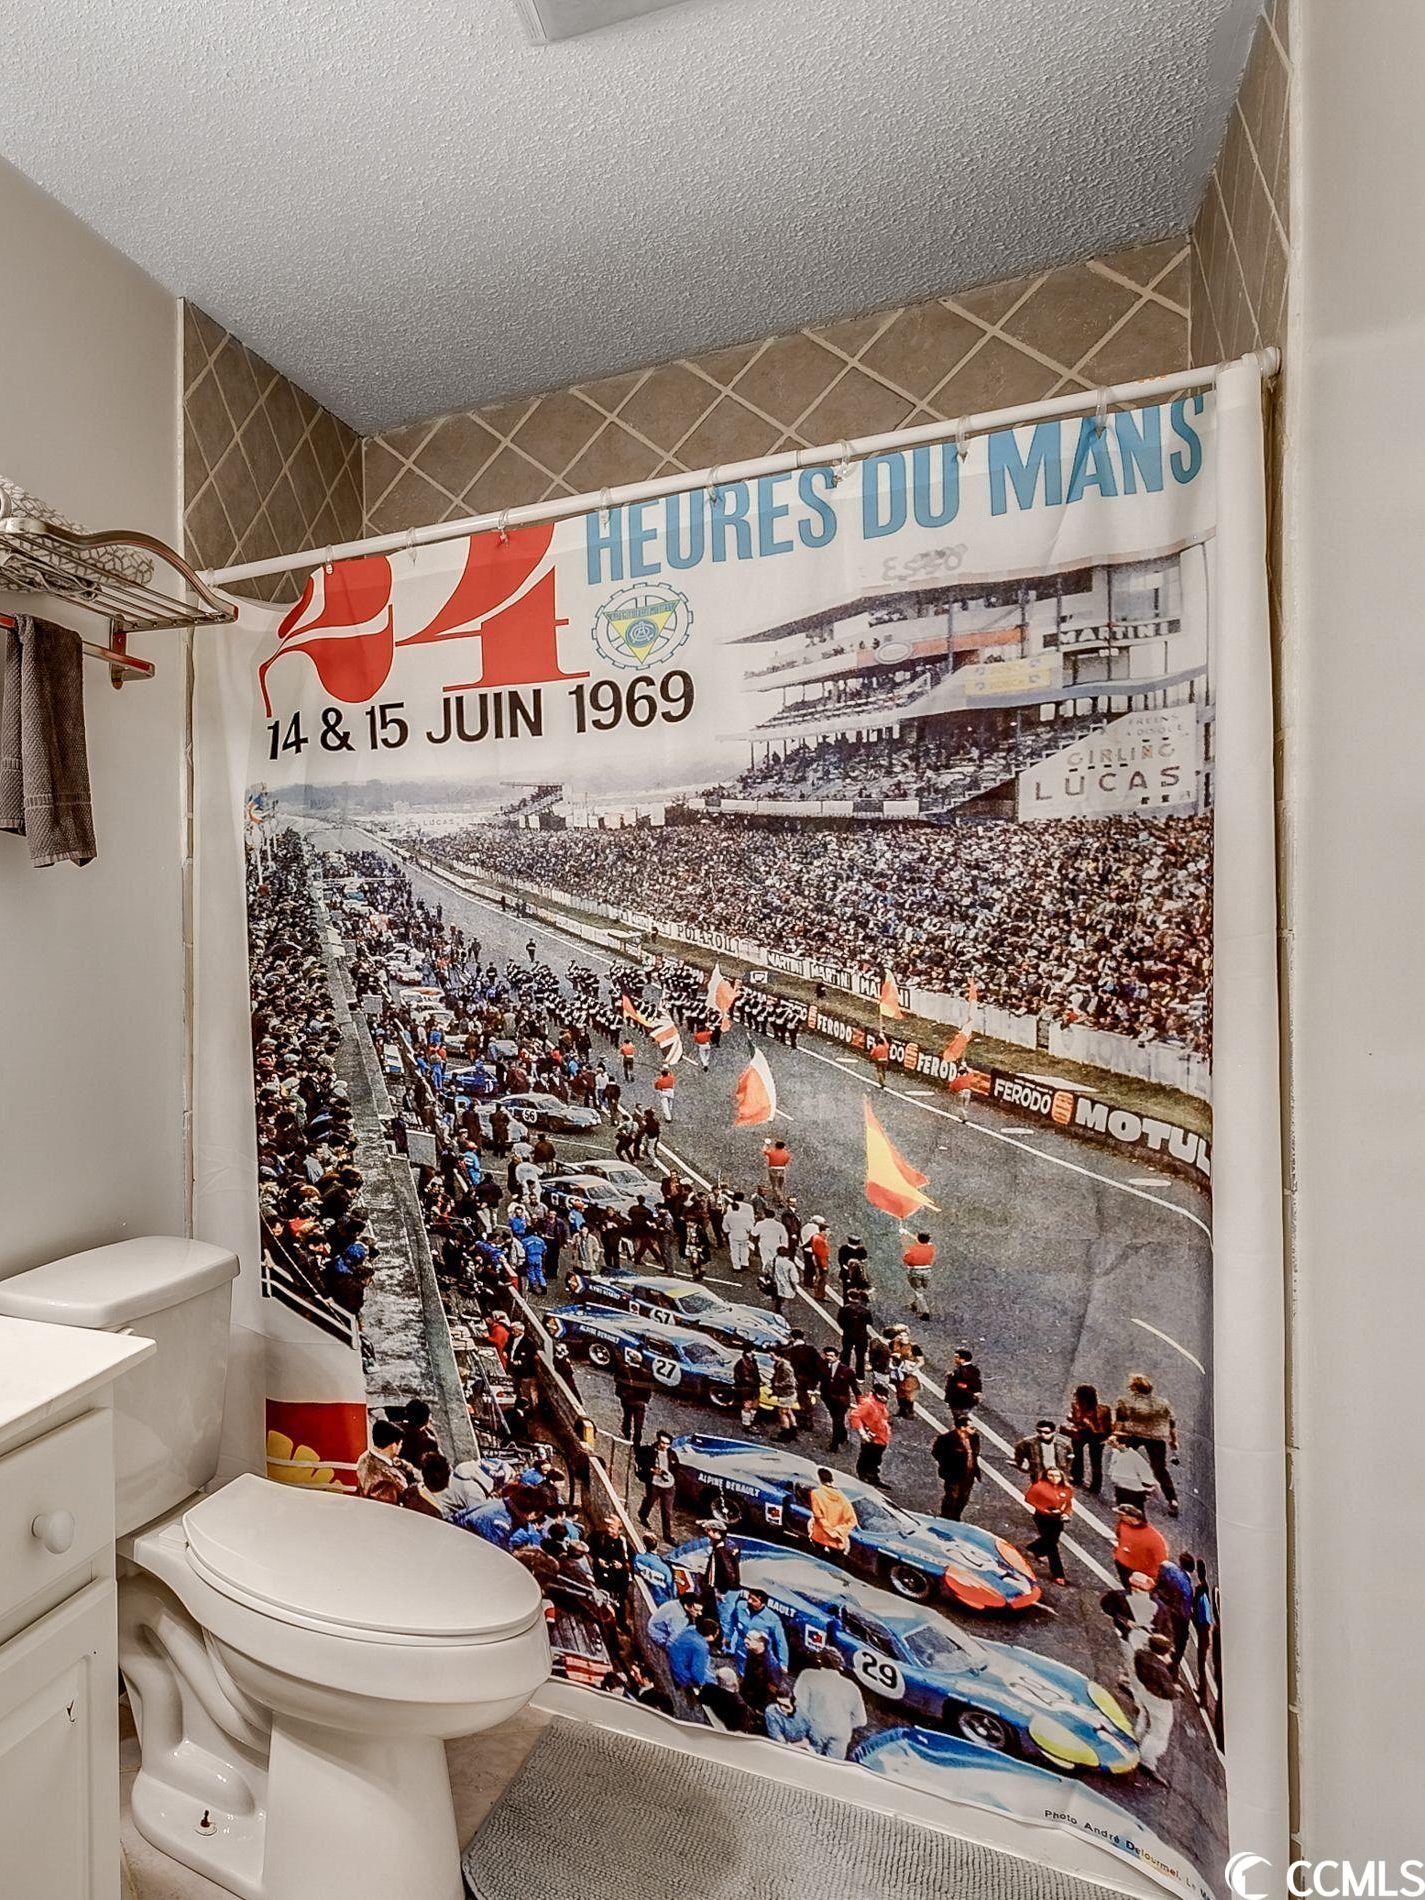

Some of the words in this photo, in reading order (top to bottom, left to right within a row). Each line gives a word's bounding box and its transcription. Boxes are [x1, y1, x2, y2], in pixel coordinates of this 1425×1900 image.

[258, 523, 590, 718] 24
[585, 466, 837, 584] HEURES
[861, 442, 960, 540] DU
[987, 394, 1205, 517] MANS
[1059, 620, 1170, 644] MARTINI
[266, 717, 309, 761] 14
[319, 706, 355, 752] &
[365, 702, 409, 750] 15
[425, 688, 543, 744] JUIN
[569, 669, 695, 734] 1969
[1067, 743, 1176, 766] GIRLING
[1035, 766, 1181, 801] LUCAS
[816, 1013, 853, 1043] FERODO
[916, 1053, 958, 1082] FEROD
[994, 1078, 1052, 1115] FERODO
[1075, 1097, 1211, 1177] MOTUL
[655, 1359, 676, 1379] 27
[697, 1472, 724, 1488] ALPINE
[862, 1650, 898, 1689] 29
[1044, 1809, 1078, 1825] Photo
[1083, 1821, 1121, 1844] André
